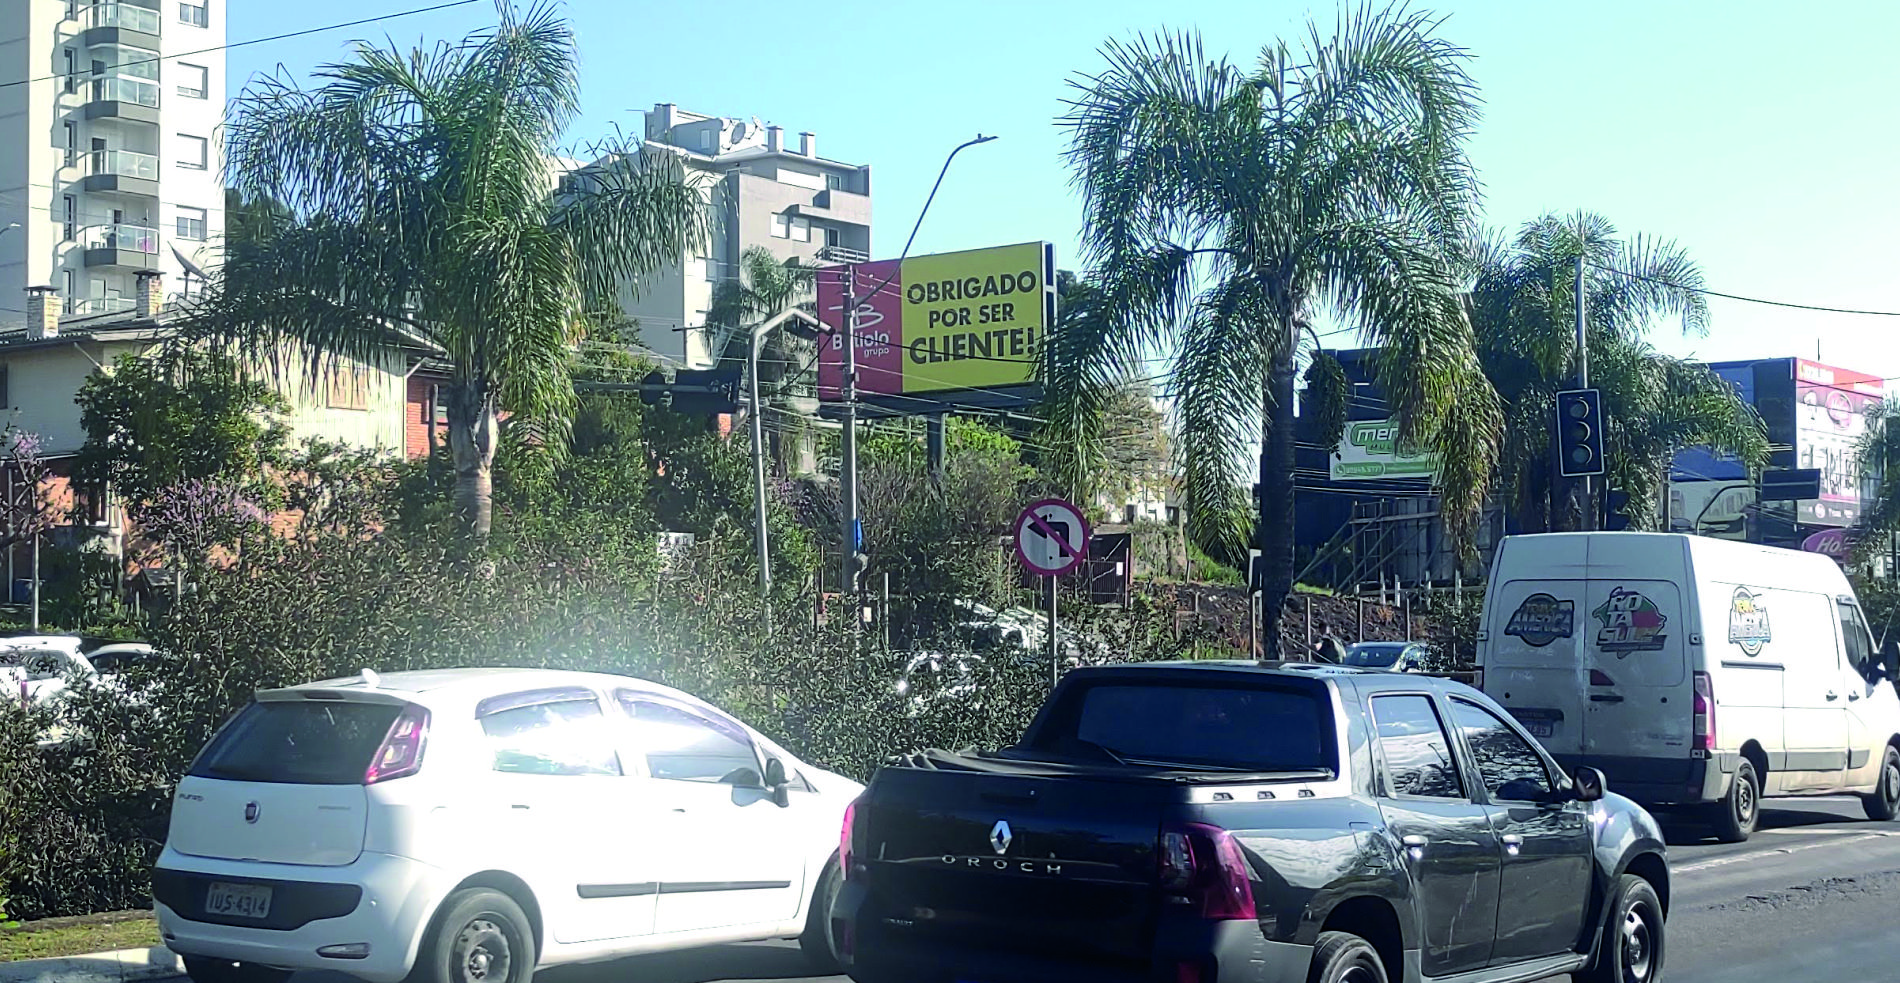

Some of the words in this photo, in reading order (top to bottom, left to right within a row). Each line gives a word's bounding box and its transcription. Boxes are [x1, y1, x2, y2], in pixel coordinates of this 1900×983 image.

[907, 270, 1036, 304] OBRIGADO
[929, 307, 972, 328] POR
[979, 303, 1015, 324] SER
[863, 347, 889, 359] grupo
[909, 327, 1035, 364] CLIENTE!
[942, 854, 1061, 874] OROCH
